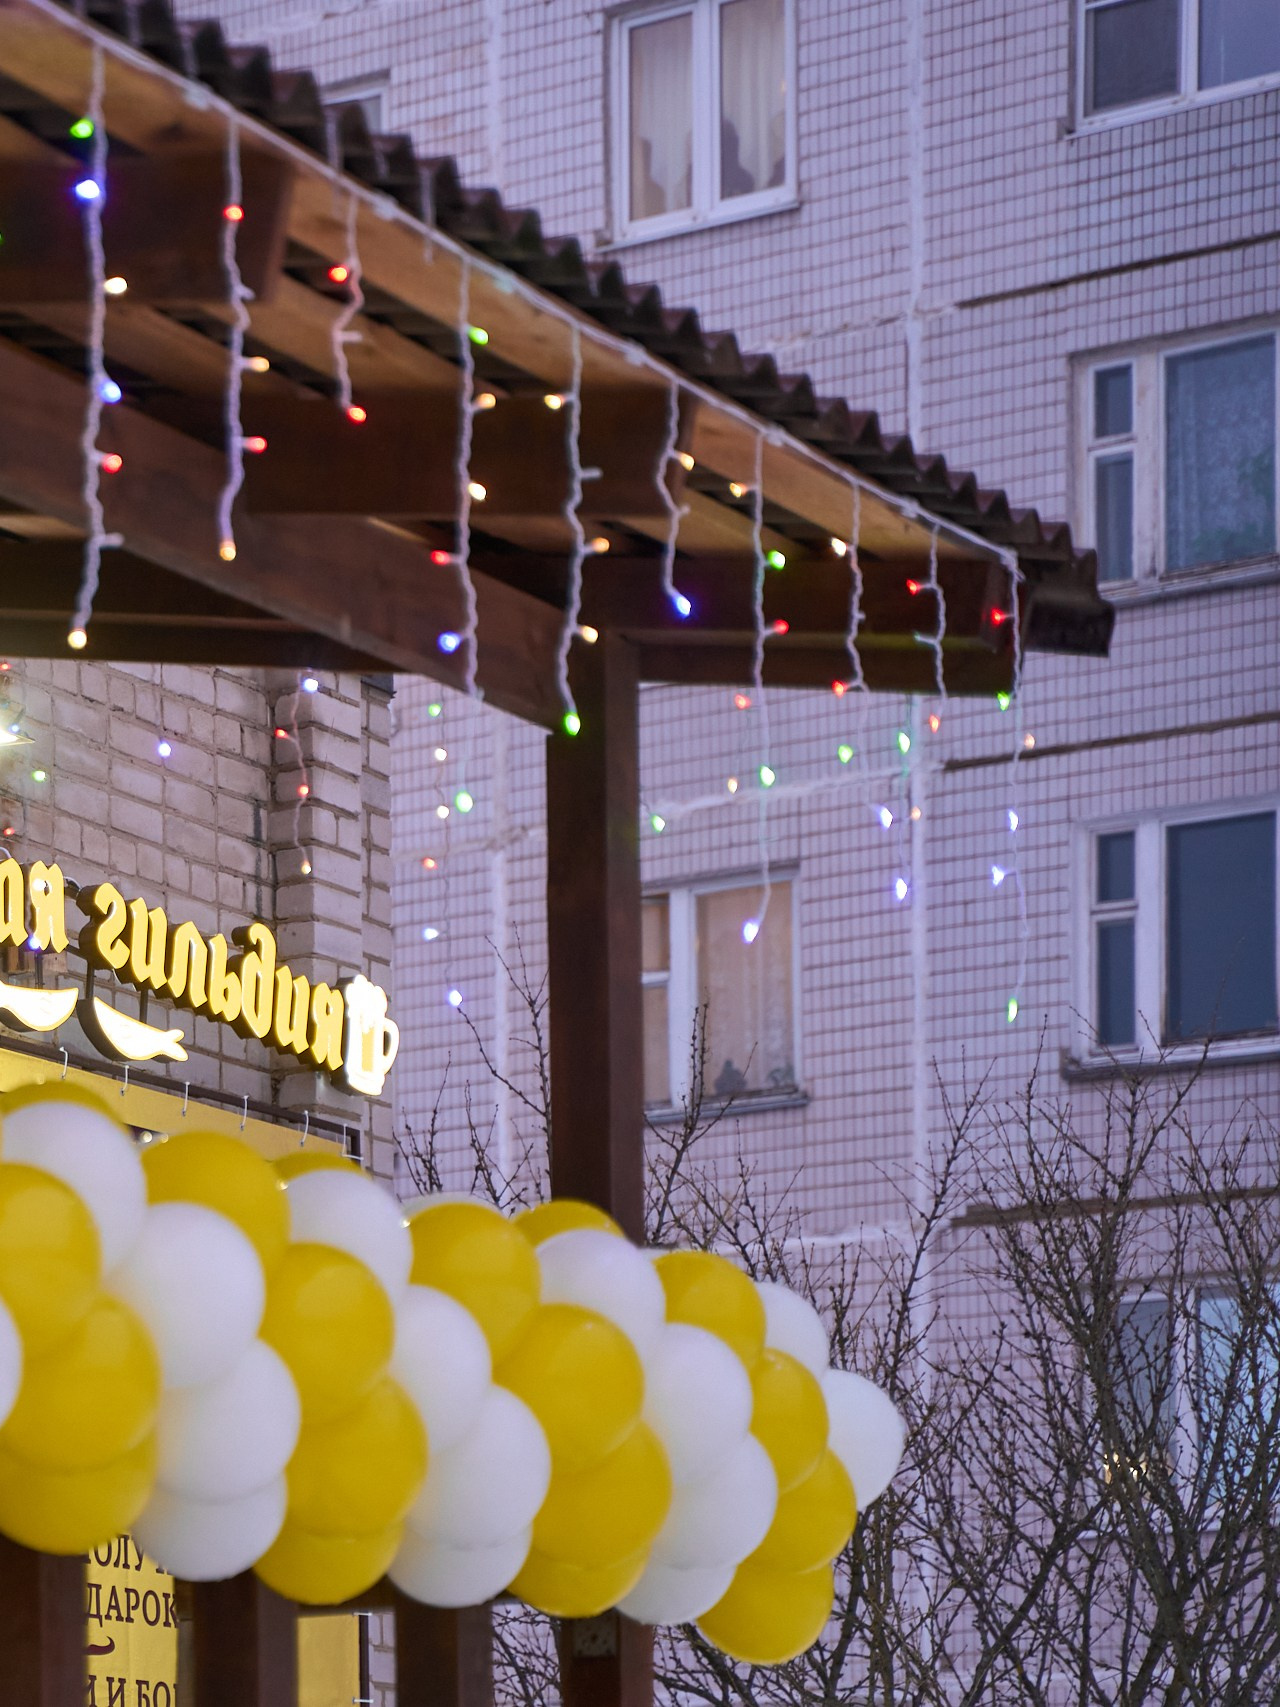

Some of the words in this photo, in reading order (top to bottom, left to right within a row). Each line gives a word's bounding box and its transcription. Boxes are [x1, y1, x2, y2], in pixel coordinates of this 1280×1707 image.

[94, 882, 344, 1071] гильдия
[86, 1582, 179, 1629] ДАРОК
[135, 1679, 178, 1707] БО
